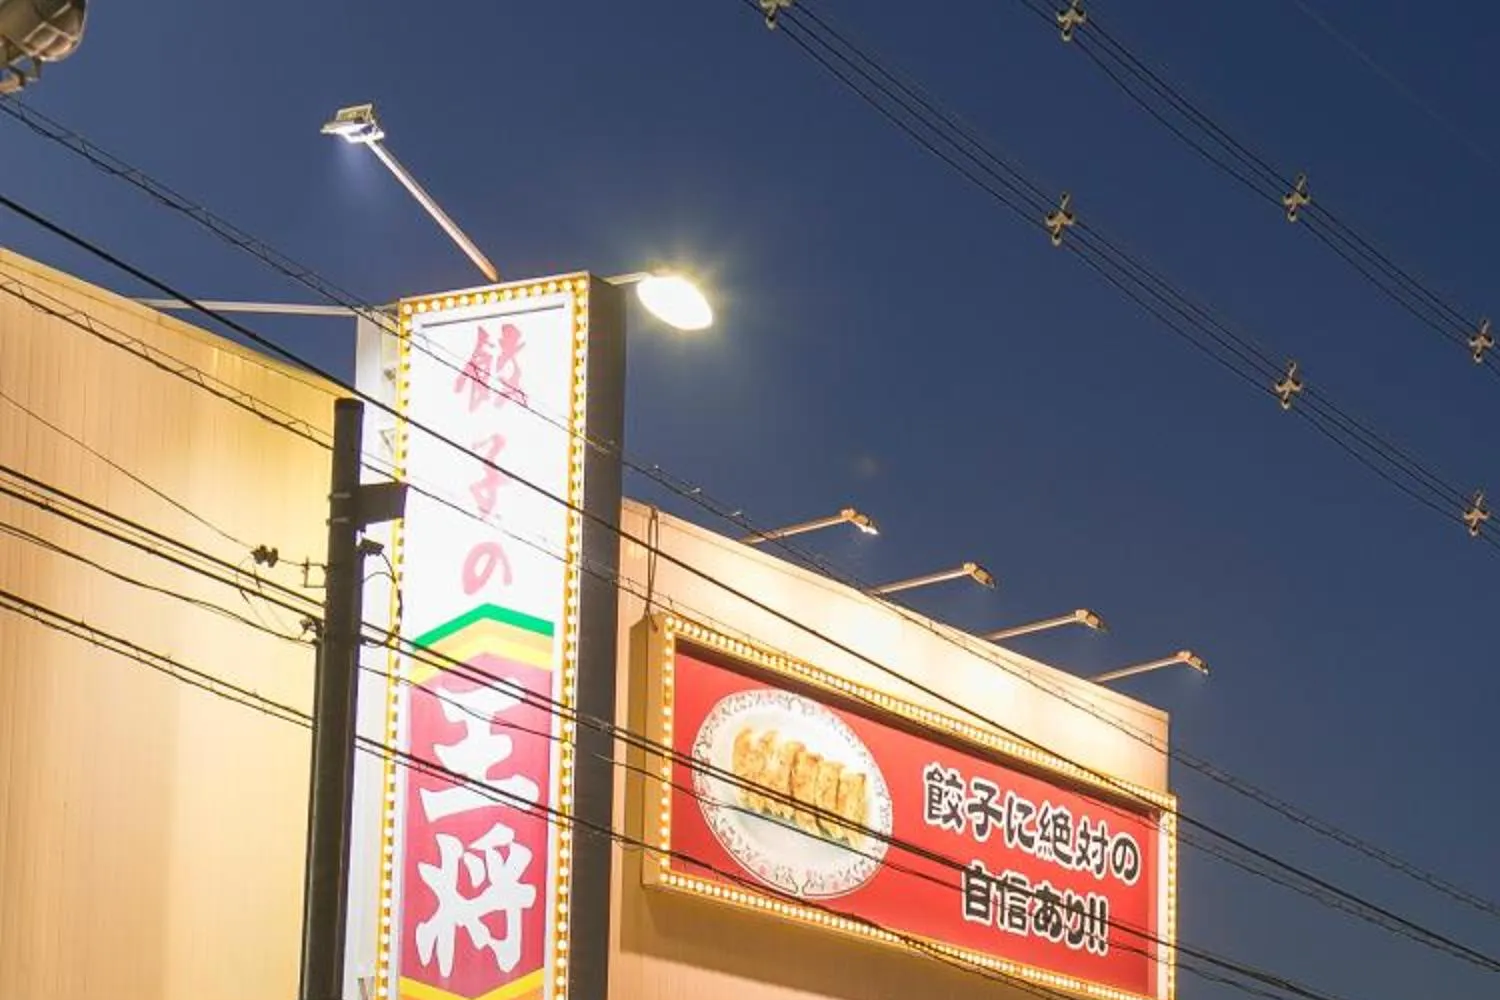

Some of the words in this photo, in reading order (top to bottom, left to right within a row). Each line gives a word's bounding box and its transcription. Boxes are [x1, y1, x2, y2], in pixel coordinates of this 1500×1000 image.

[454, 323, 530, 596] 餃子の
[415, 676, 540, 978] 王将
[922, 762, 1141, 886] 餃子に絶対の
